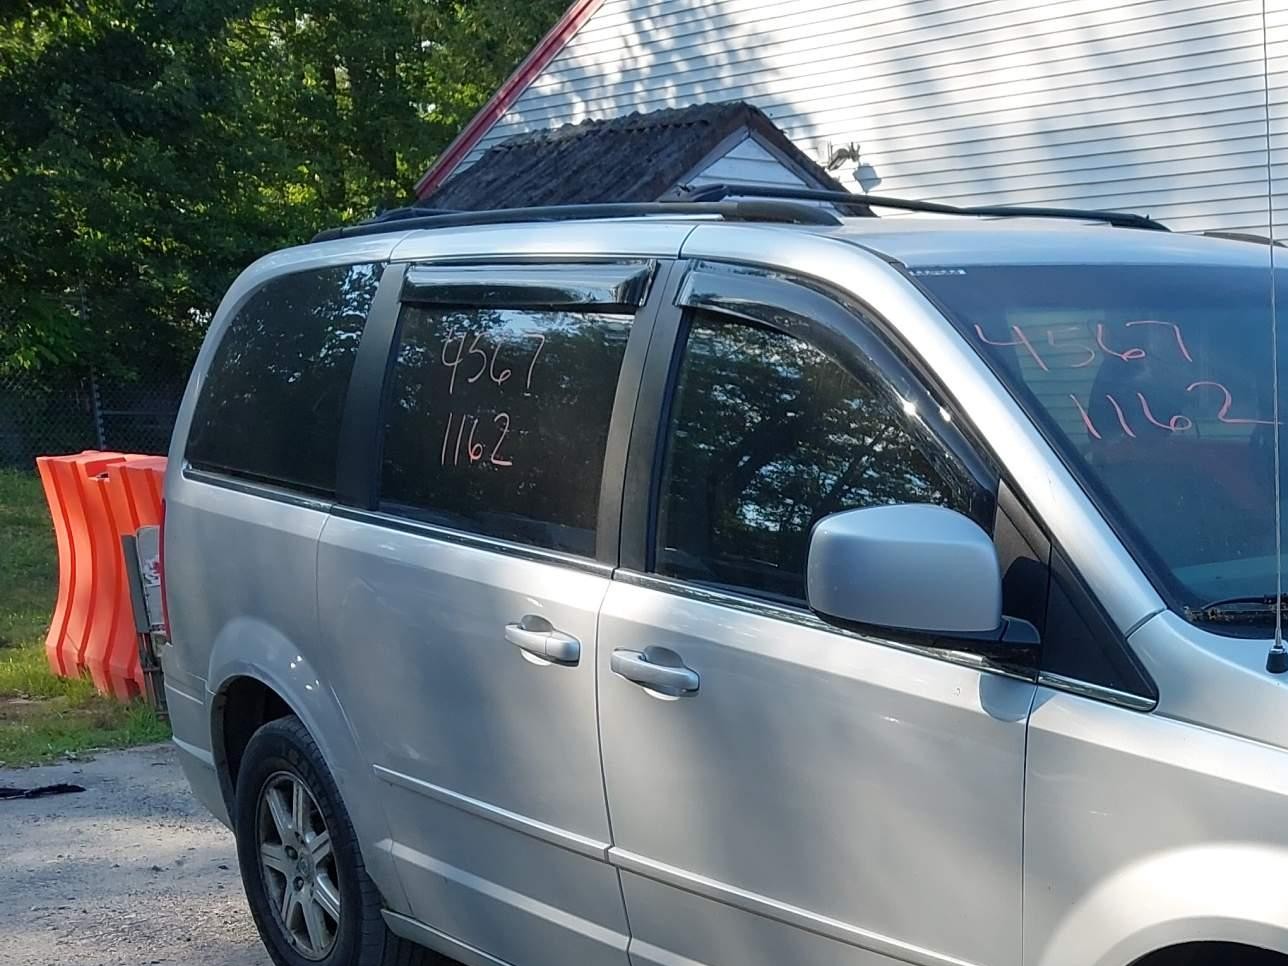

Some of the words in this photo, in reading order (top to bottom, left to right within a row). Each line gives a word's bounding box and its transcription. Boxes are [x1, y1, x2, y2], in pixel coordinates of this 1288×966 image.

[441, 327, 546, 395] 4567
[973, 319, 1193, 372] 4567
[440, 411, 513, 467] 1162
[1069, 381, 1283, 440] 1162
